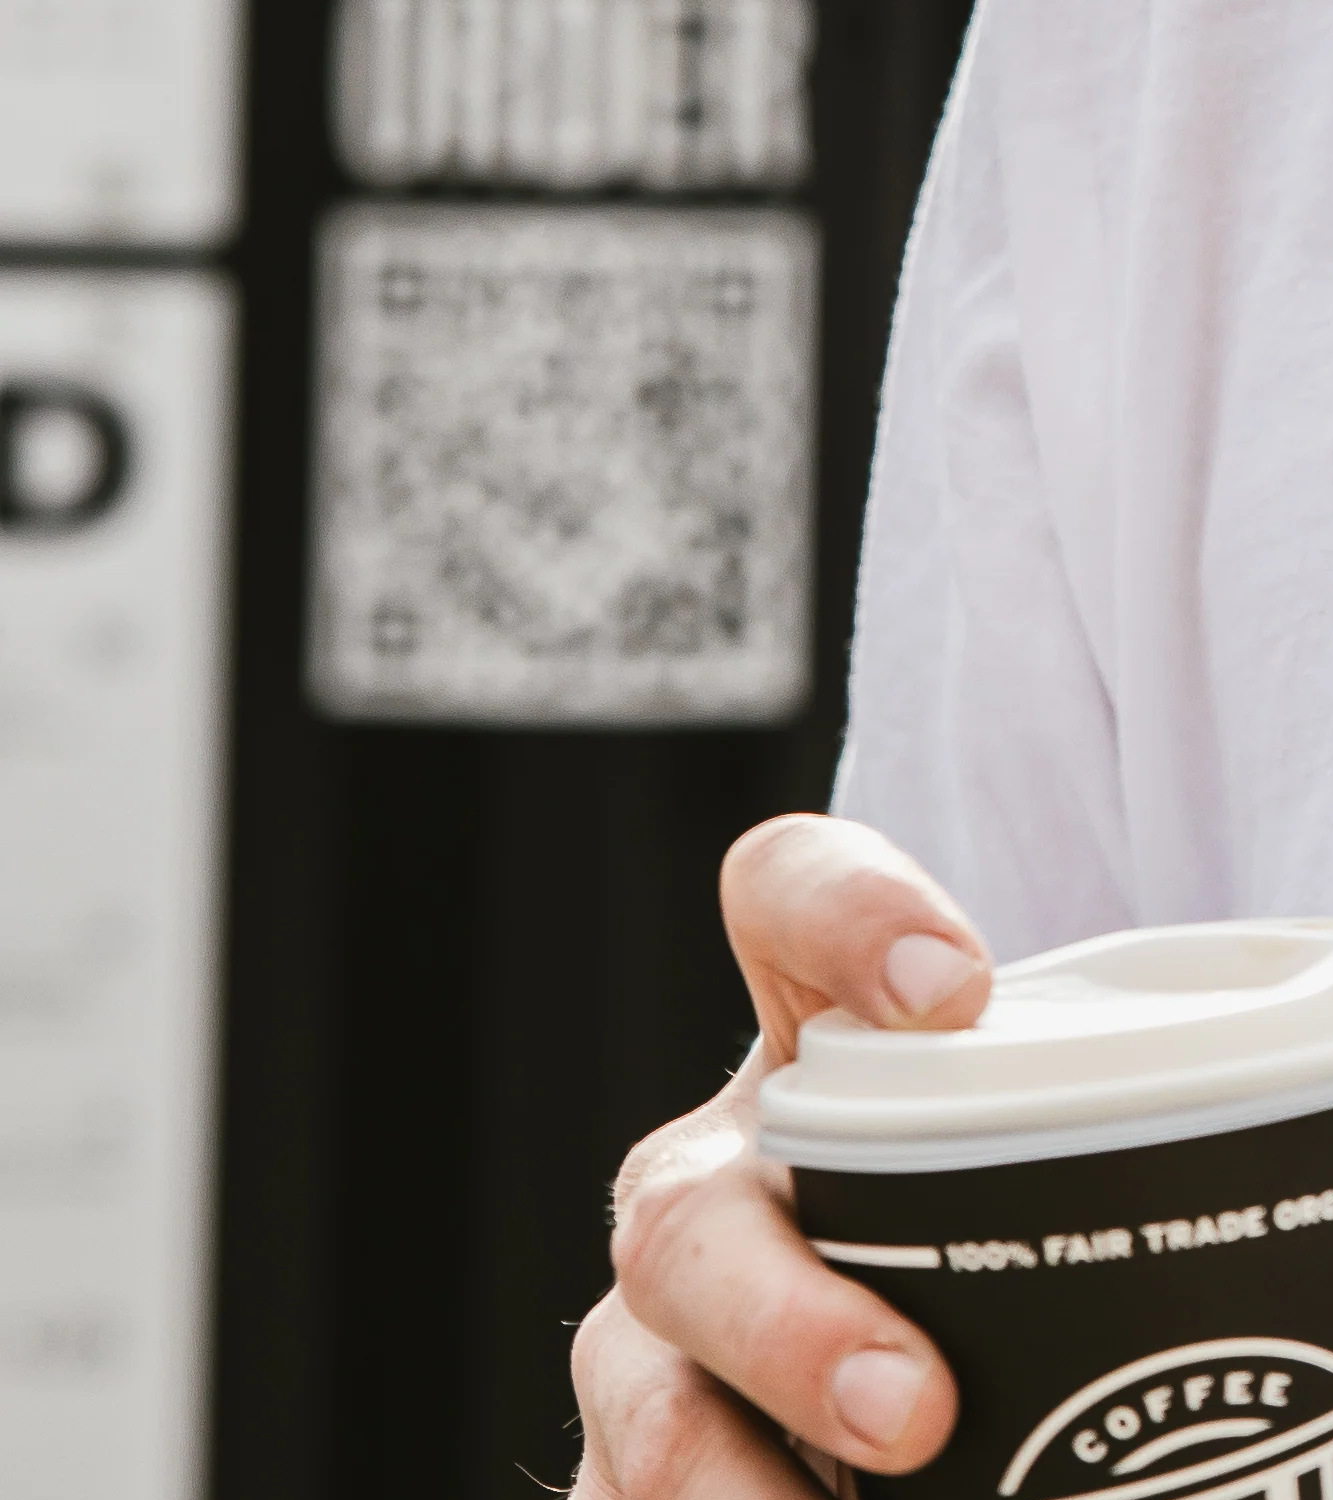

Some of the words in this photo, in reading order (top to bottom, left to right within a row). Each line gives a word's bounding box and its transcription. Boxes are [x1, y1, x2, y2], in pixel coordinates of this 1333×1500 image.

[945, 1239, 1038, 1273] 100%
[1041, 1227, 1134, 1267] FAIR
[1140, 1203, 1268, 1256] TRADE
[1071, 1369, 1294, 1464] COFFEE
